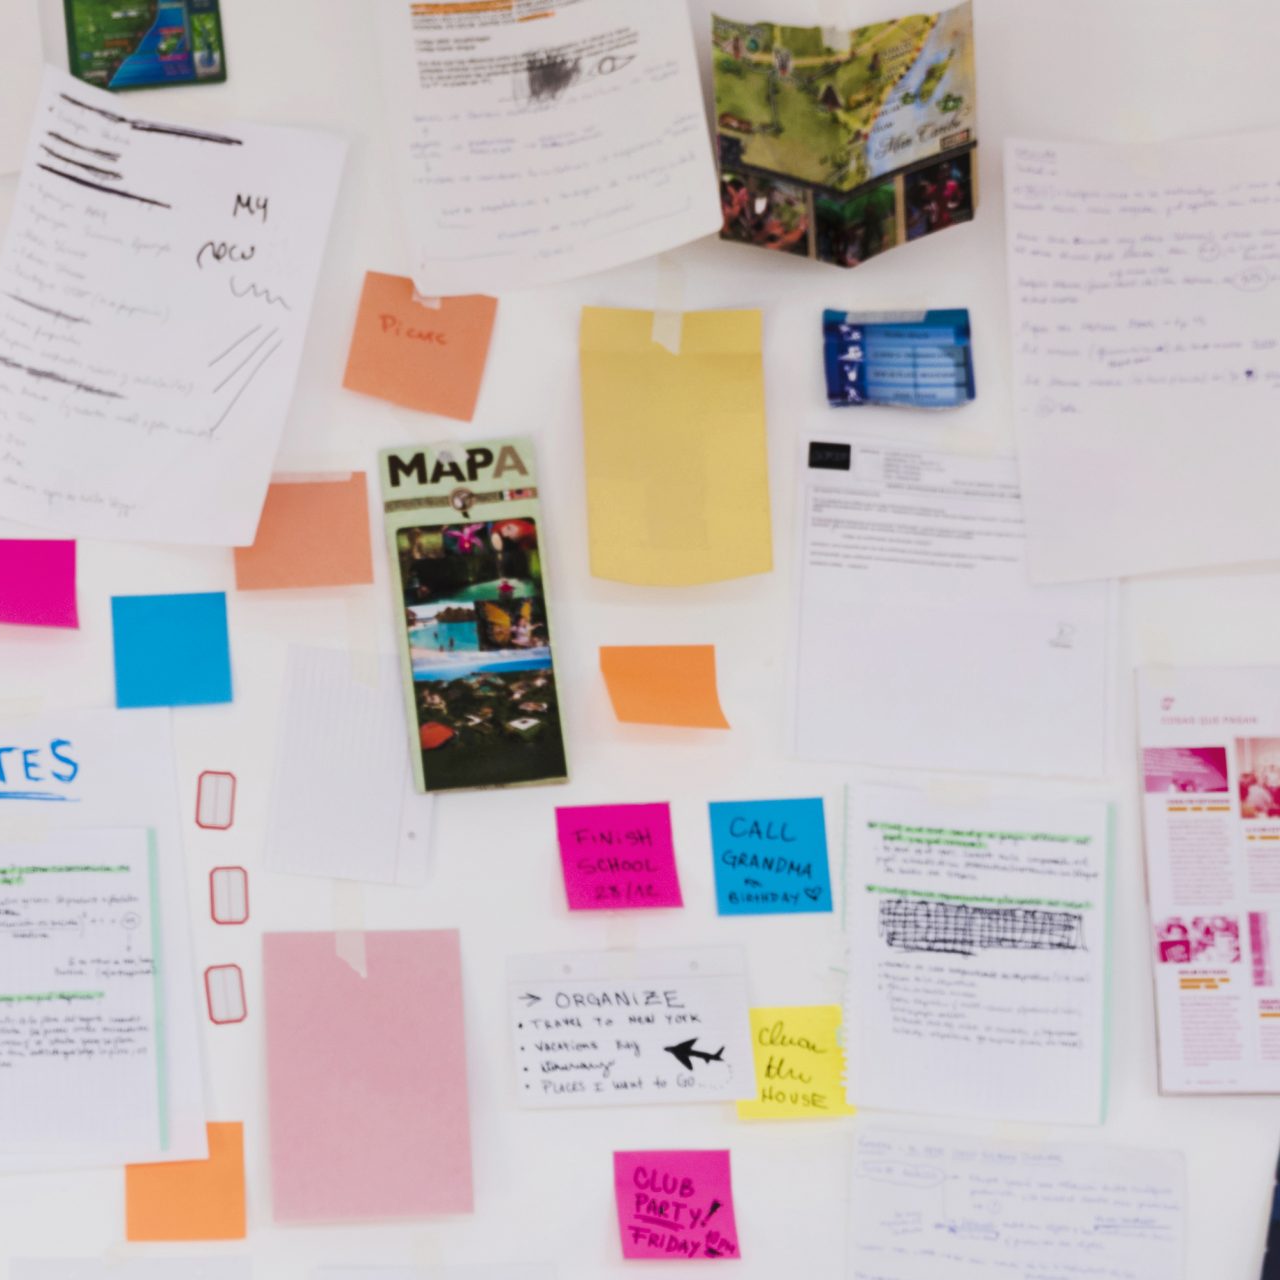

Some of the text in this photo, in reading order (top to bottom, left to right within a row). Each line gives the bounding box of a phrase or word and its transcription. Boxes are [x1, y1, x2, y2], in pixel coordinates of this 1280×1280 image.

[387, 444, 529, 488] MAPA
[728, 816, 797, 843] CALL
[576, 856, 658, 876] SCHOOL
[721, 849, 814, 879] GRANDMA
[555, 989, 685, 1010] ORGANIZE
[633, 1166, 696, 1198] CLUB
[627, 1226, 701, 1259] FRIDAY
